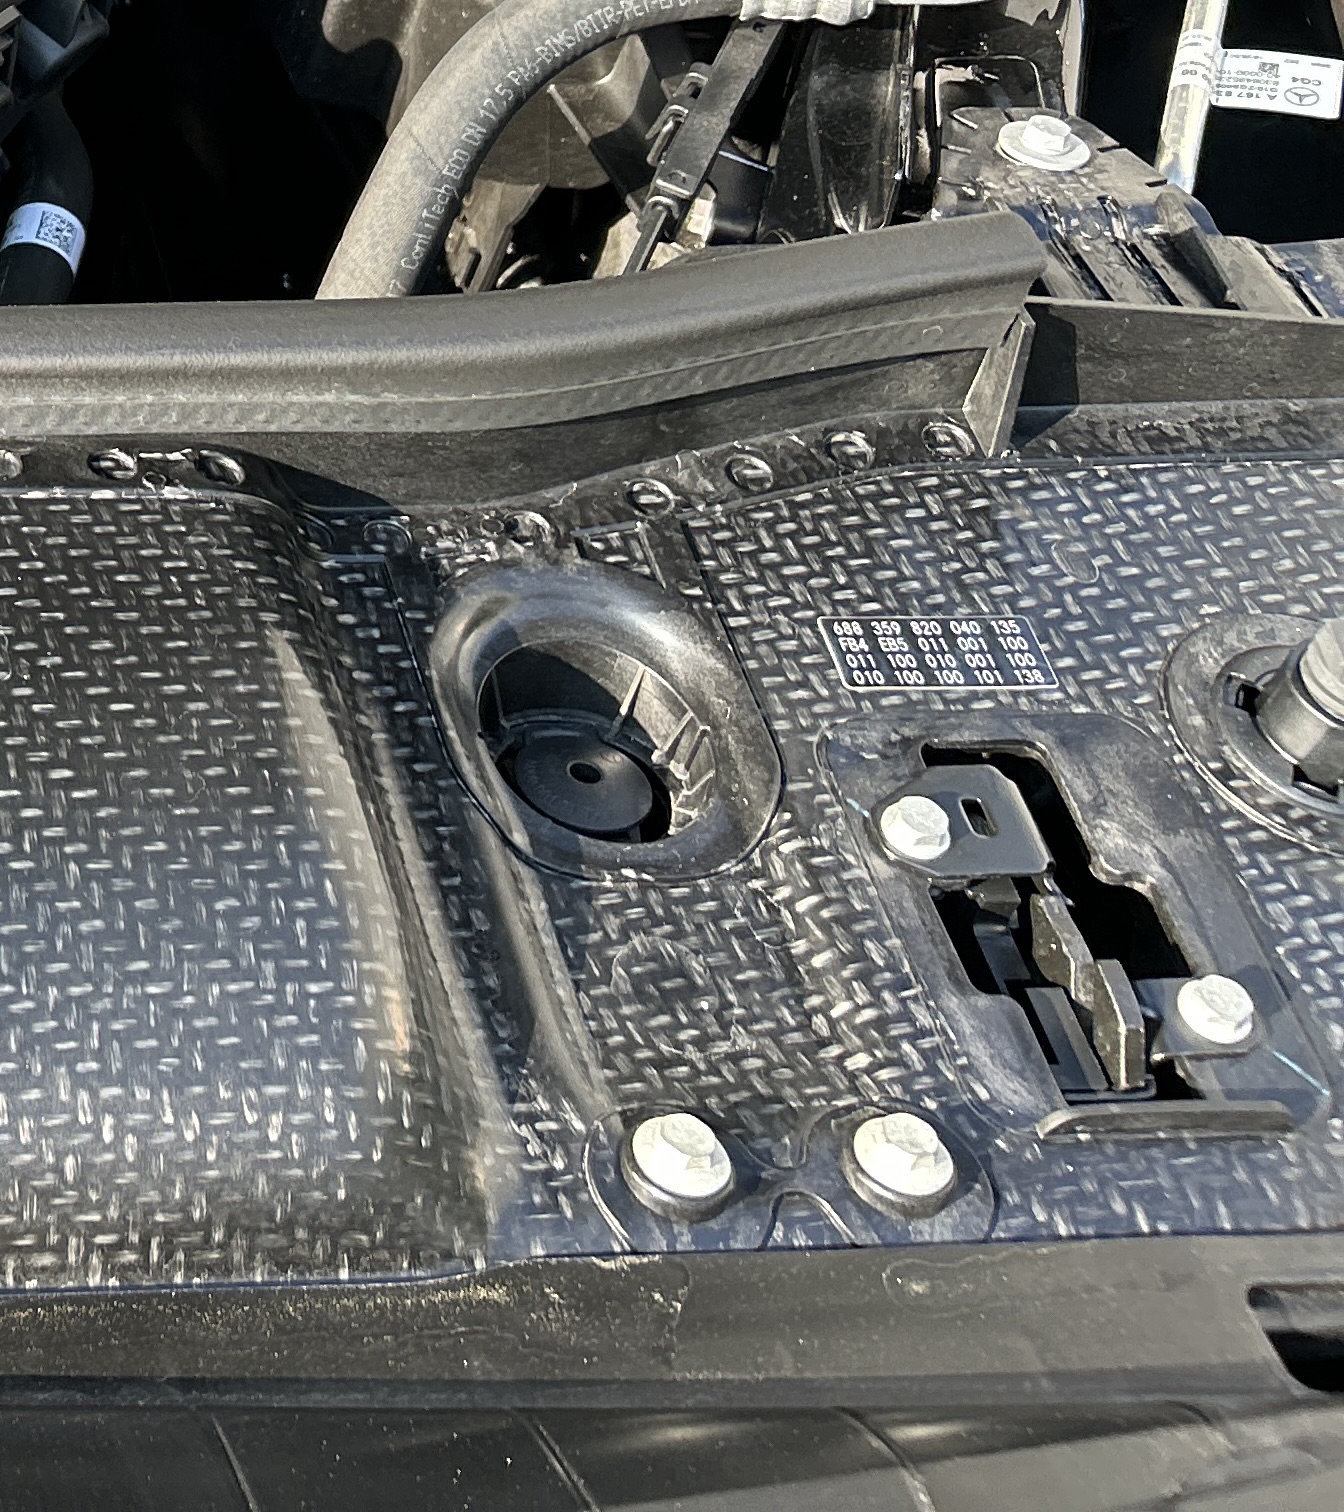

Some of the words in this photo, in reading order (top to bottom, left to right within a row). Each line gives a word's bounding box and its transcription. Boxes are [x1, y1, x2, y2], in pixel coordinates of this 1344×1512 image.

[833, 620, 864, 636] 688
[870, 620, 901, 636] 359
[910, 620, 942, 636] 820
[950, 620, 981, 636] 040
[990, 620, 1020, 636] 135
[839, 637, 869, 652] FB4
[878, 637, 908, 652] EB5
[918, 637, 948, 652] 011
[957, 637, 988, 652] 001
[998, 637, 1028, 652] 100
[846, 654, 876, 669] 011
[887, 654, 917, 669] 100
[925, 654, 956, 669] 010
[965, 654, 996, 669] 001
[1006, 654, 1036, 669] 100
[853, 669, 884, 685] 010
[894, 669, 925, 685] 100
[934, 669, 964, 685] 100
[974, 669, 1004, 685] 101
[1013, 669, 1045, 685] 138
